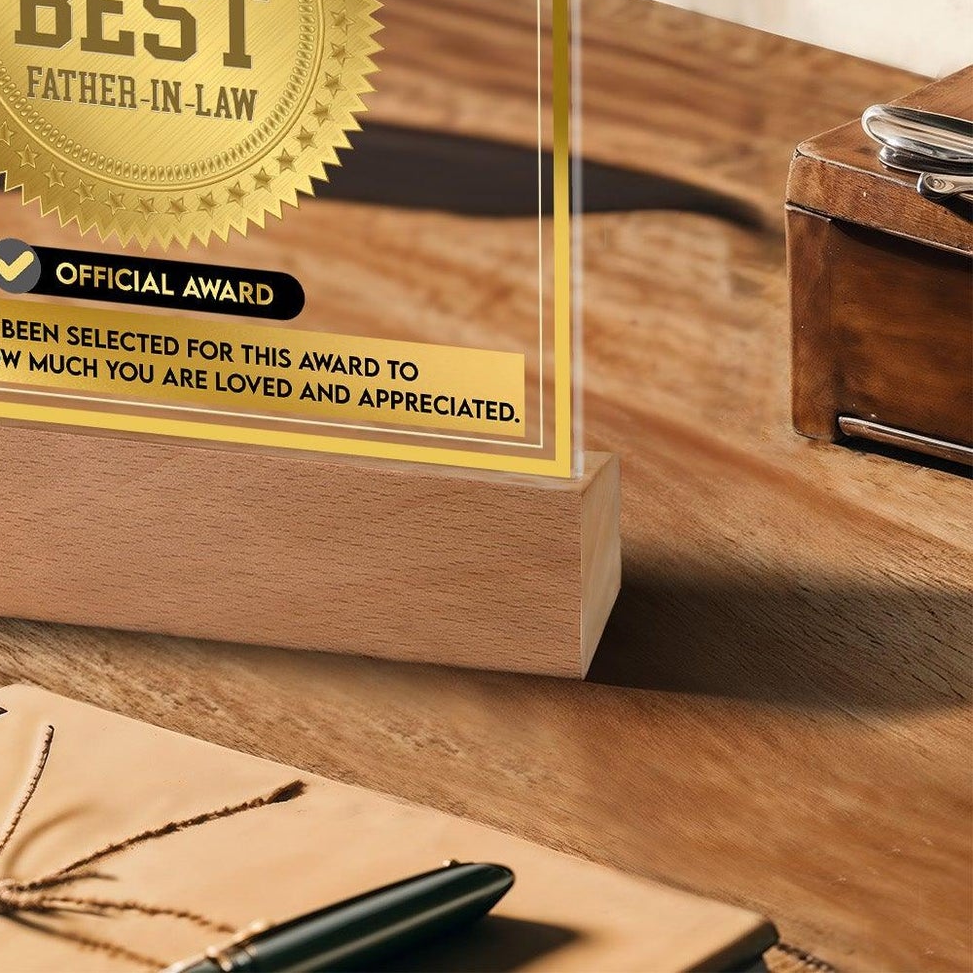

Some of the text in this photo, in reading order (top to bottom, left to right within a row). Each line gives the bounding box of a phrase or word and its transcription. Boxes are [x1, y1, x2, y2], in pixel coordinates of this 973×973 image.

[27, 65, 258, 122] FATHER-IN-LAW
[56, 262, 274, 306] OFFICIAL AWARD
[2, 319, 59, 344] BEEN
[66, 326, 179, 356] SELECTED
[187, 339, 233, 362] FOR
[240, 344, 292, 369] THIS
[298, 351, 380, 378] AWARD
[387, 359, 419, 382] TO
[29, 352, 98, 378] MUCH
[105, 360, 154, 384] YOU
[162, 367, 207, 389] ARE
[215, 372, 293, 398] LOVED
[299, 382, 351, 404] AND
[358, 388, 520, 424] APPRECIATED.
